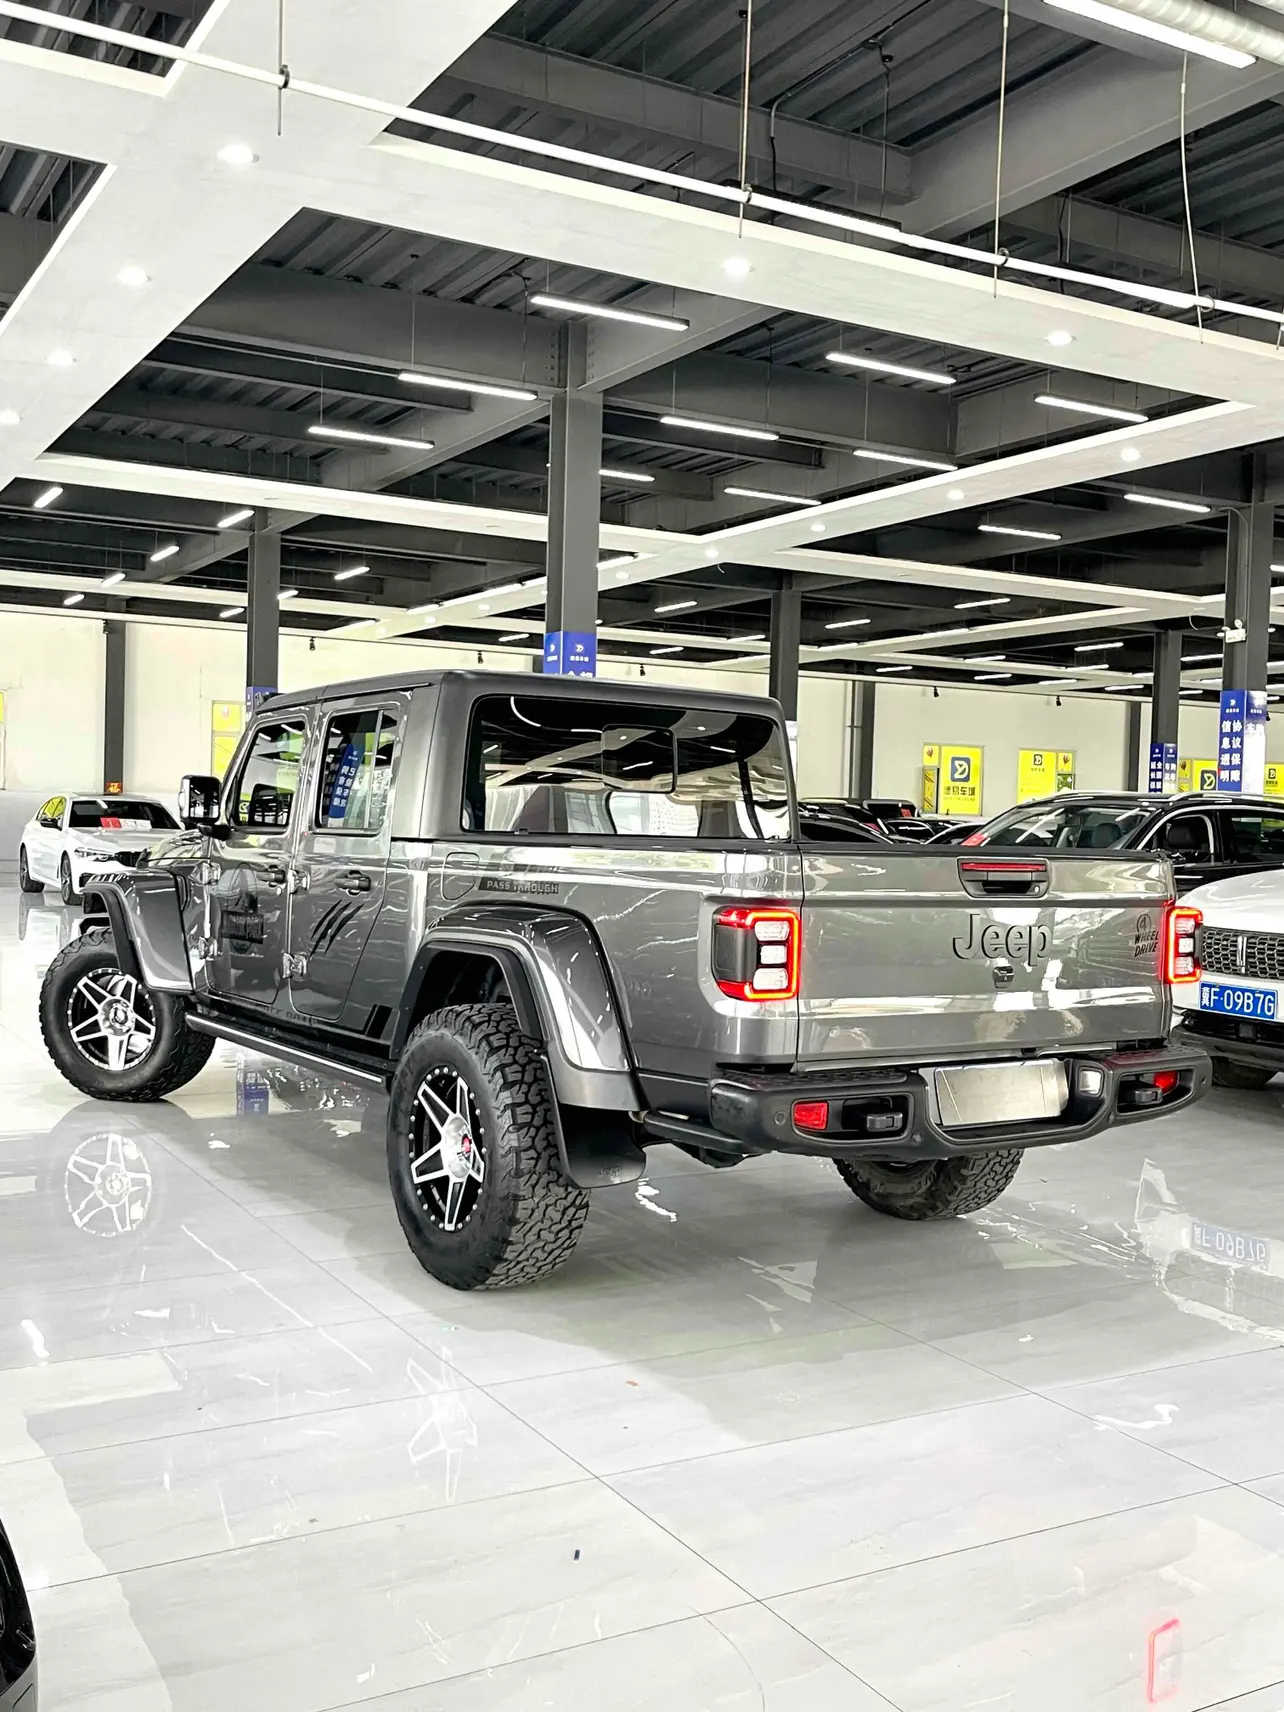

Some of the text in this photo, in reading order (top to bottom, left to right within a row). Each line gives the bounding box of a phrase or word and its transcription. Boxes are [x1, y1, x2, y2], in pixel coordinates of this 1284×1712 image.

[486, 879, 559, 894] PASS THROUGH
[952, 913, 1053, 966] Jeep
[1134, 930, 1160, 945] WHEEL
[1134, 942, 1159, 957] DRIVE
